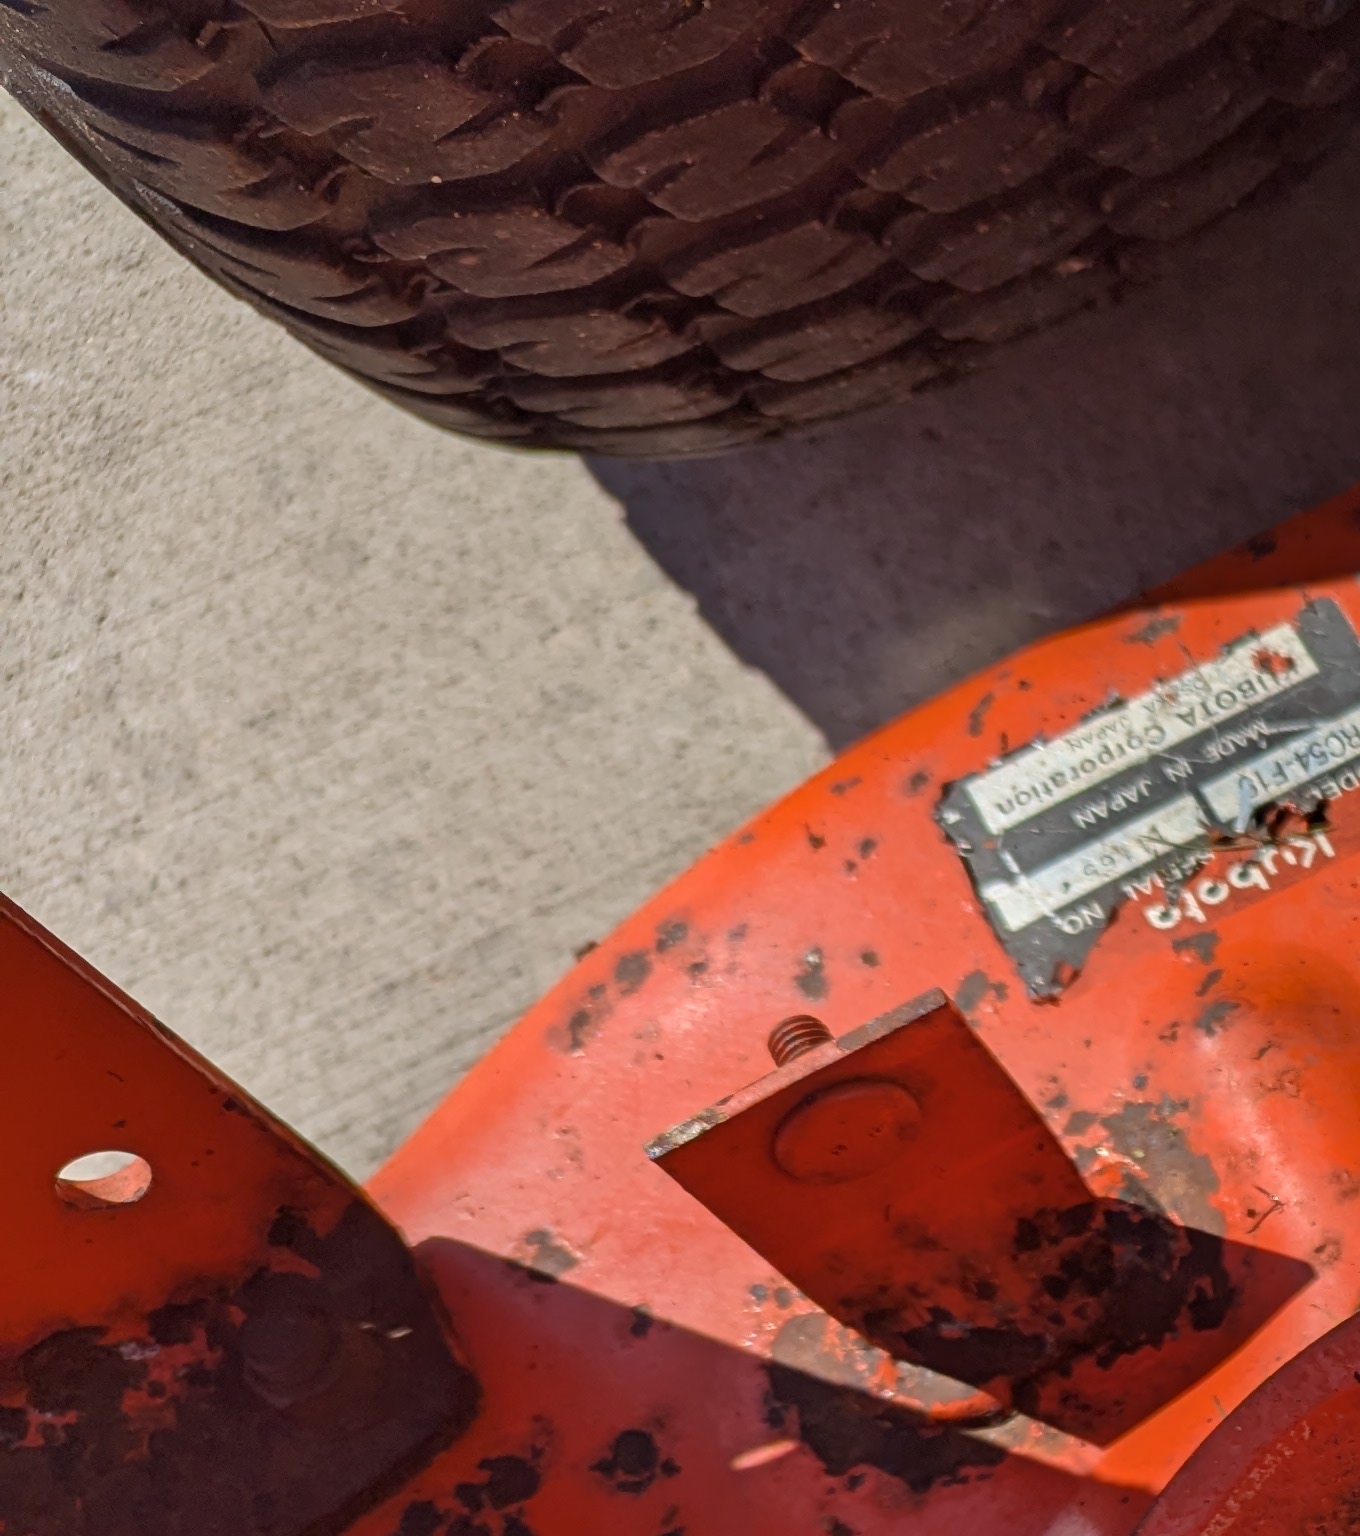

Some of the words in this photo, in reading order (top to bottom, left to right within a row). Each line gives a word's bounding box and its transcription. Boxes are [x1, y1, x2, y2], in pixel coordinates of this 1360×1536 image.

[1066, 712, 1132, 757] JAPAN
[1198, 714, 1271, 765] MADE
[994, 721, 1168, 817] Corporation
[1161, 755, 1193, 785] IN
[1070, 774, 1156, 832] JAPAN
[1142, 829, 1335, 931] Kubota
